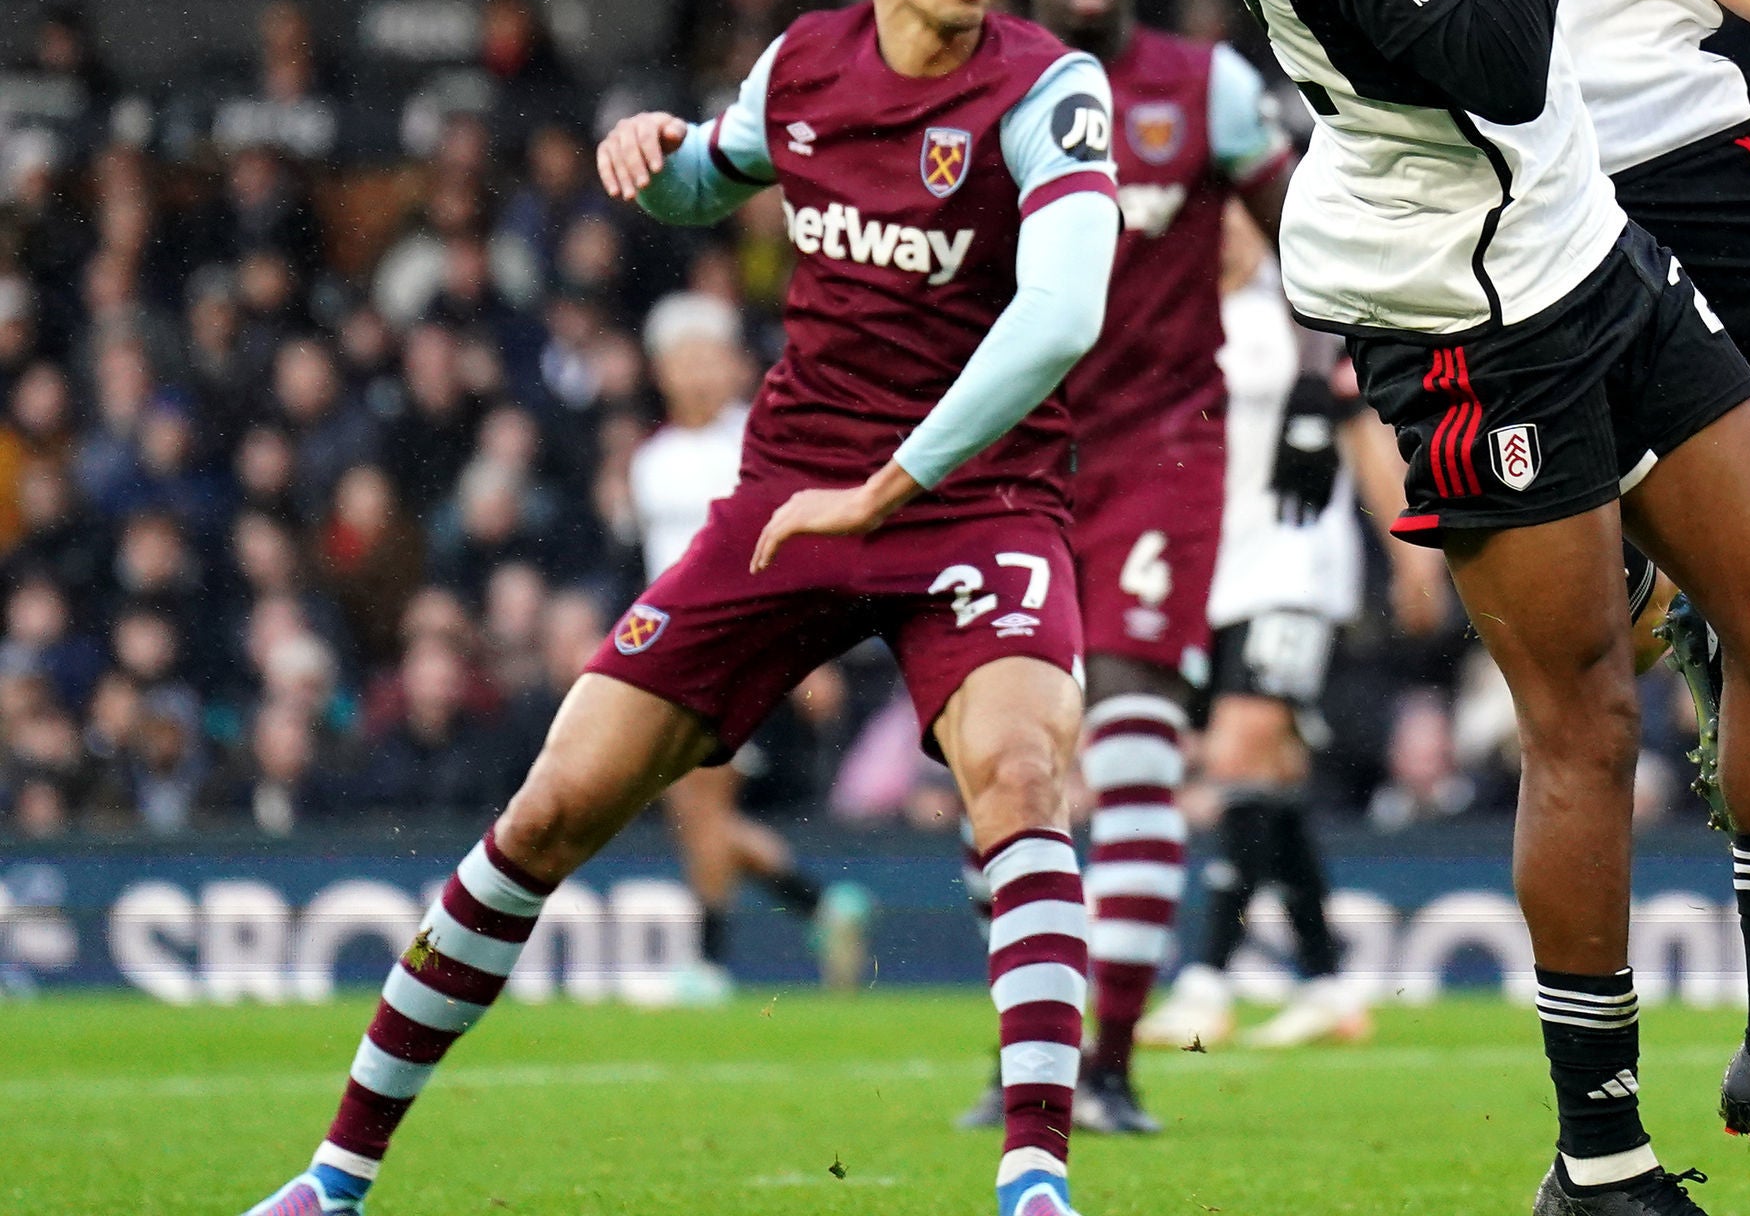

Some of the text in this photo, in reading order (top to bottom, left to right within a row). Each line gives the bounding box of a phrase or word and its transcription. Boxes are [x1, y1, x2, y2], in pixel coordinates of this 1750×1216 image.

[1061, 107, 1109, 151] JD
[1504, 433, 1529, 478] FFC
[927, 552, 1050, 628] 27
[1118, 529, 1172, 608] 4
